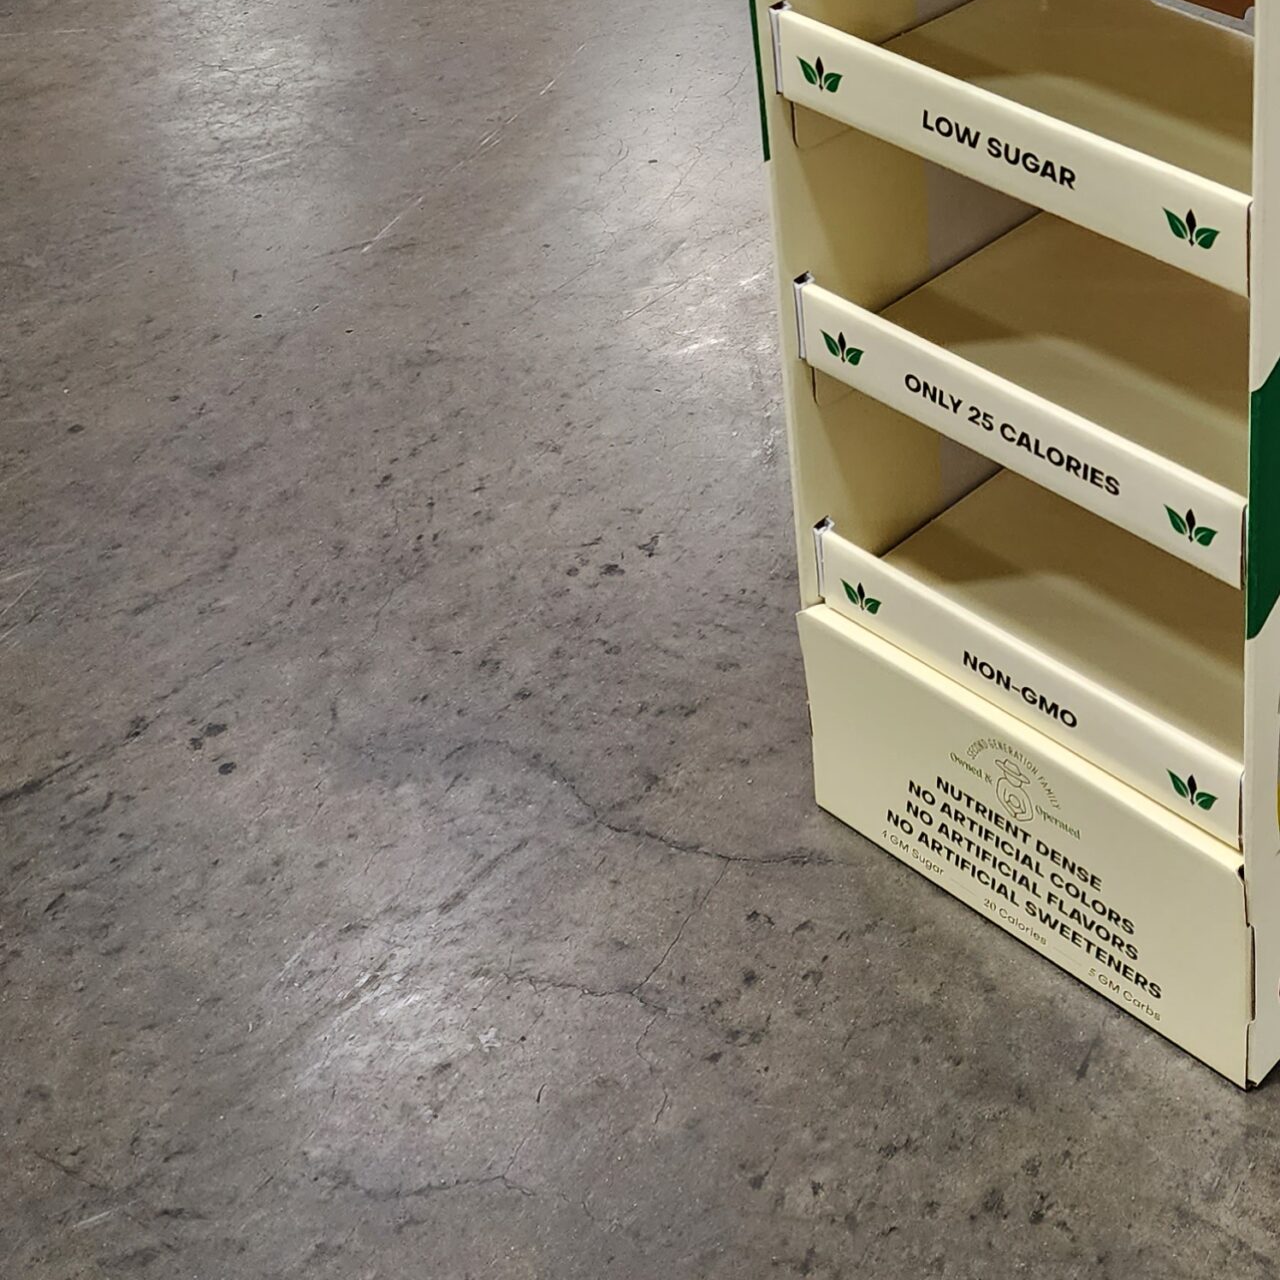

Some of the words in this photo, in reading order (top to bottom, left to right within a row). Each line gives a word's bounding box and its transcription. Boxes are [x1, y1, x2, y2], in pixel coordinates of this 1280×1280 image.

[922, 109, 980, 149] LOW
[987, 137, 1077, 190] SUGAR
[905, 373, 964, 414] ONLY
[967, 407, 994, 431] 25
[1000, 422, 1121, 496] CALORIES
[963, 650, 1078, 728] NON-GMO
[950, 752, 983, 778] Owned
[966, 739, 988, 760] SECOND
[988, 738, 1039, 775] GENERATION
[1038, 776, 1061, 810] FAMILY
[890, 834, 909, 853] GM
[911, 848, 944, 875] Sugar
[908, 780, 936, 806] NO
[939, 802, 1044, 878] ARTIFICIAL
[1050, 873, 1135, 936] COLORS
[935, 775, 1032, 845] NUTRIENT
[1036, 839, 1103, 893] DENSE
[1035, 805, 1081, 840] Operated
[886, 809, 913, 836] NO
[917, 830, 1020, 907] ARTIFICIAL
[1025, 900, 1162, 1000] SWEETENERS
[905, 800, 933, 826] NO
[937, 822, 1042, 898] ARTIFICIAL
[1046, 892, 1139, 961] FLAVORS
[983, 897, 997, 912] 20
[998, 907, 1047, 946] Calories
[1088, 967, 1096, 978] 5
[1097, 972, 1120, 994] GM
[1122, 990, 1162, 1022] Carbs
